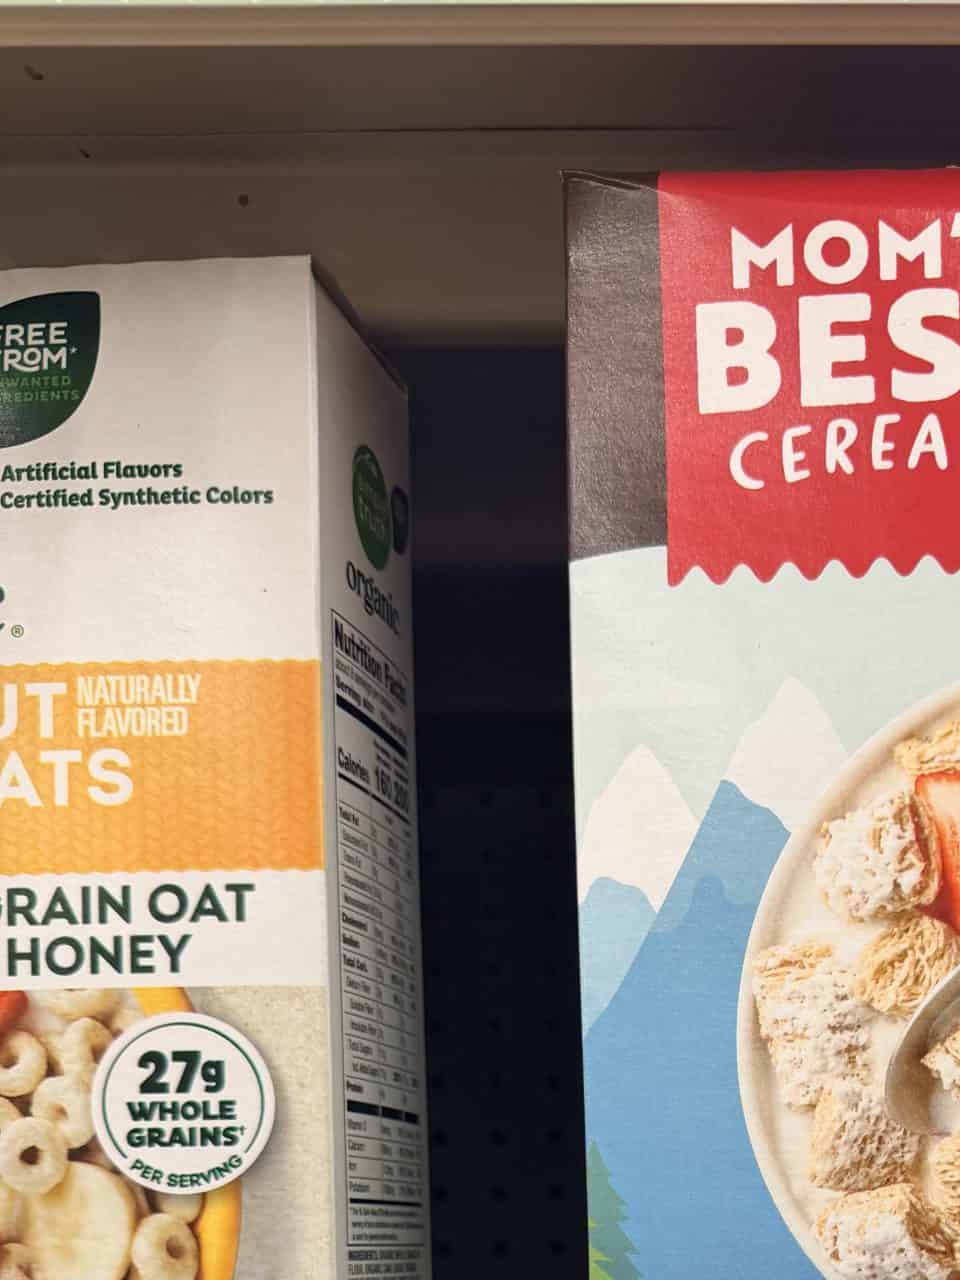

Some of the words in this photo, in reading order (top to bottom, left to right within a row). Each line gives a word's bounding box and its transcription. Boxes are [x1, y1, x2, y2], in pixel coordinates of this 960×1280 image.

[0, 322, 67, 346] REE
[1, 462, 98, 482] Artificial
[103, 461, 183, 479] Flavors
[0, 488, 94, 509] Certified
[99, 487, 201, 510] Synthetic
[206, 486, 274, 504] Colors
[345, 561, 400, 635] organic
[76, 673, 200, 705] NATURALLY
[76, 706, 188, 737] FLAVORED
[0, 885, 131, 926] RAIN
[148, 883, 255, 923] OAT
[7, 934, 193, 976] HONEY
[137, 1050, 226, 1094] 27g
[126, 1100, 237, 1121] WHOLE
[131, 1159, 164, 1184] PER
[167, 1155, 243, 1188] SERVING
